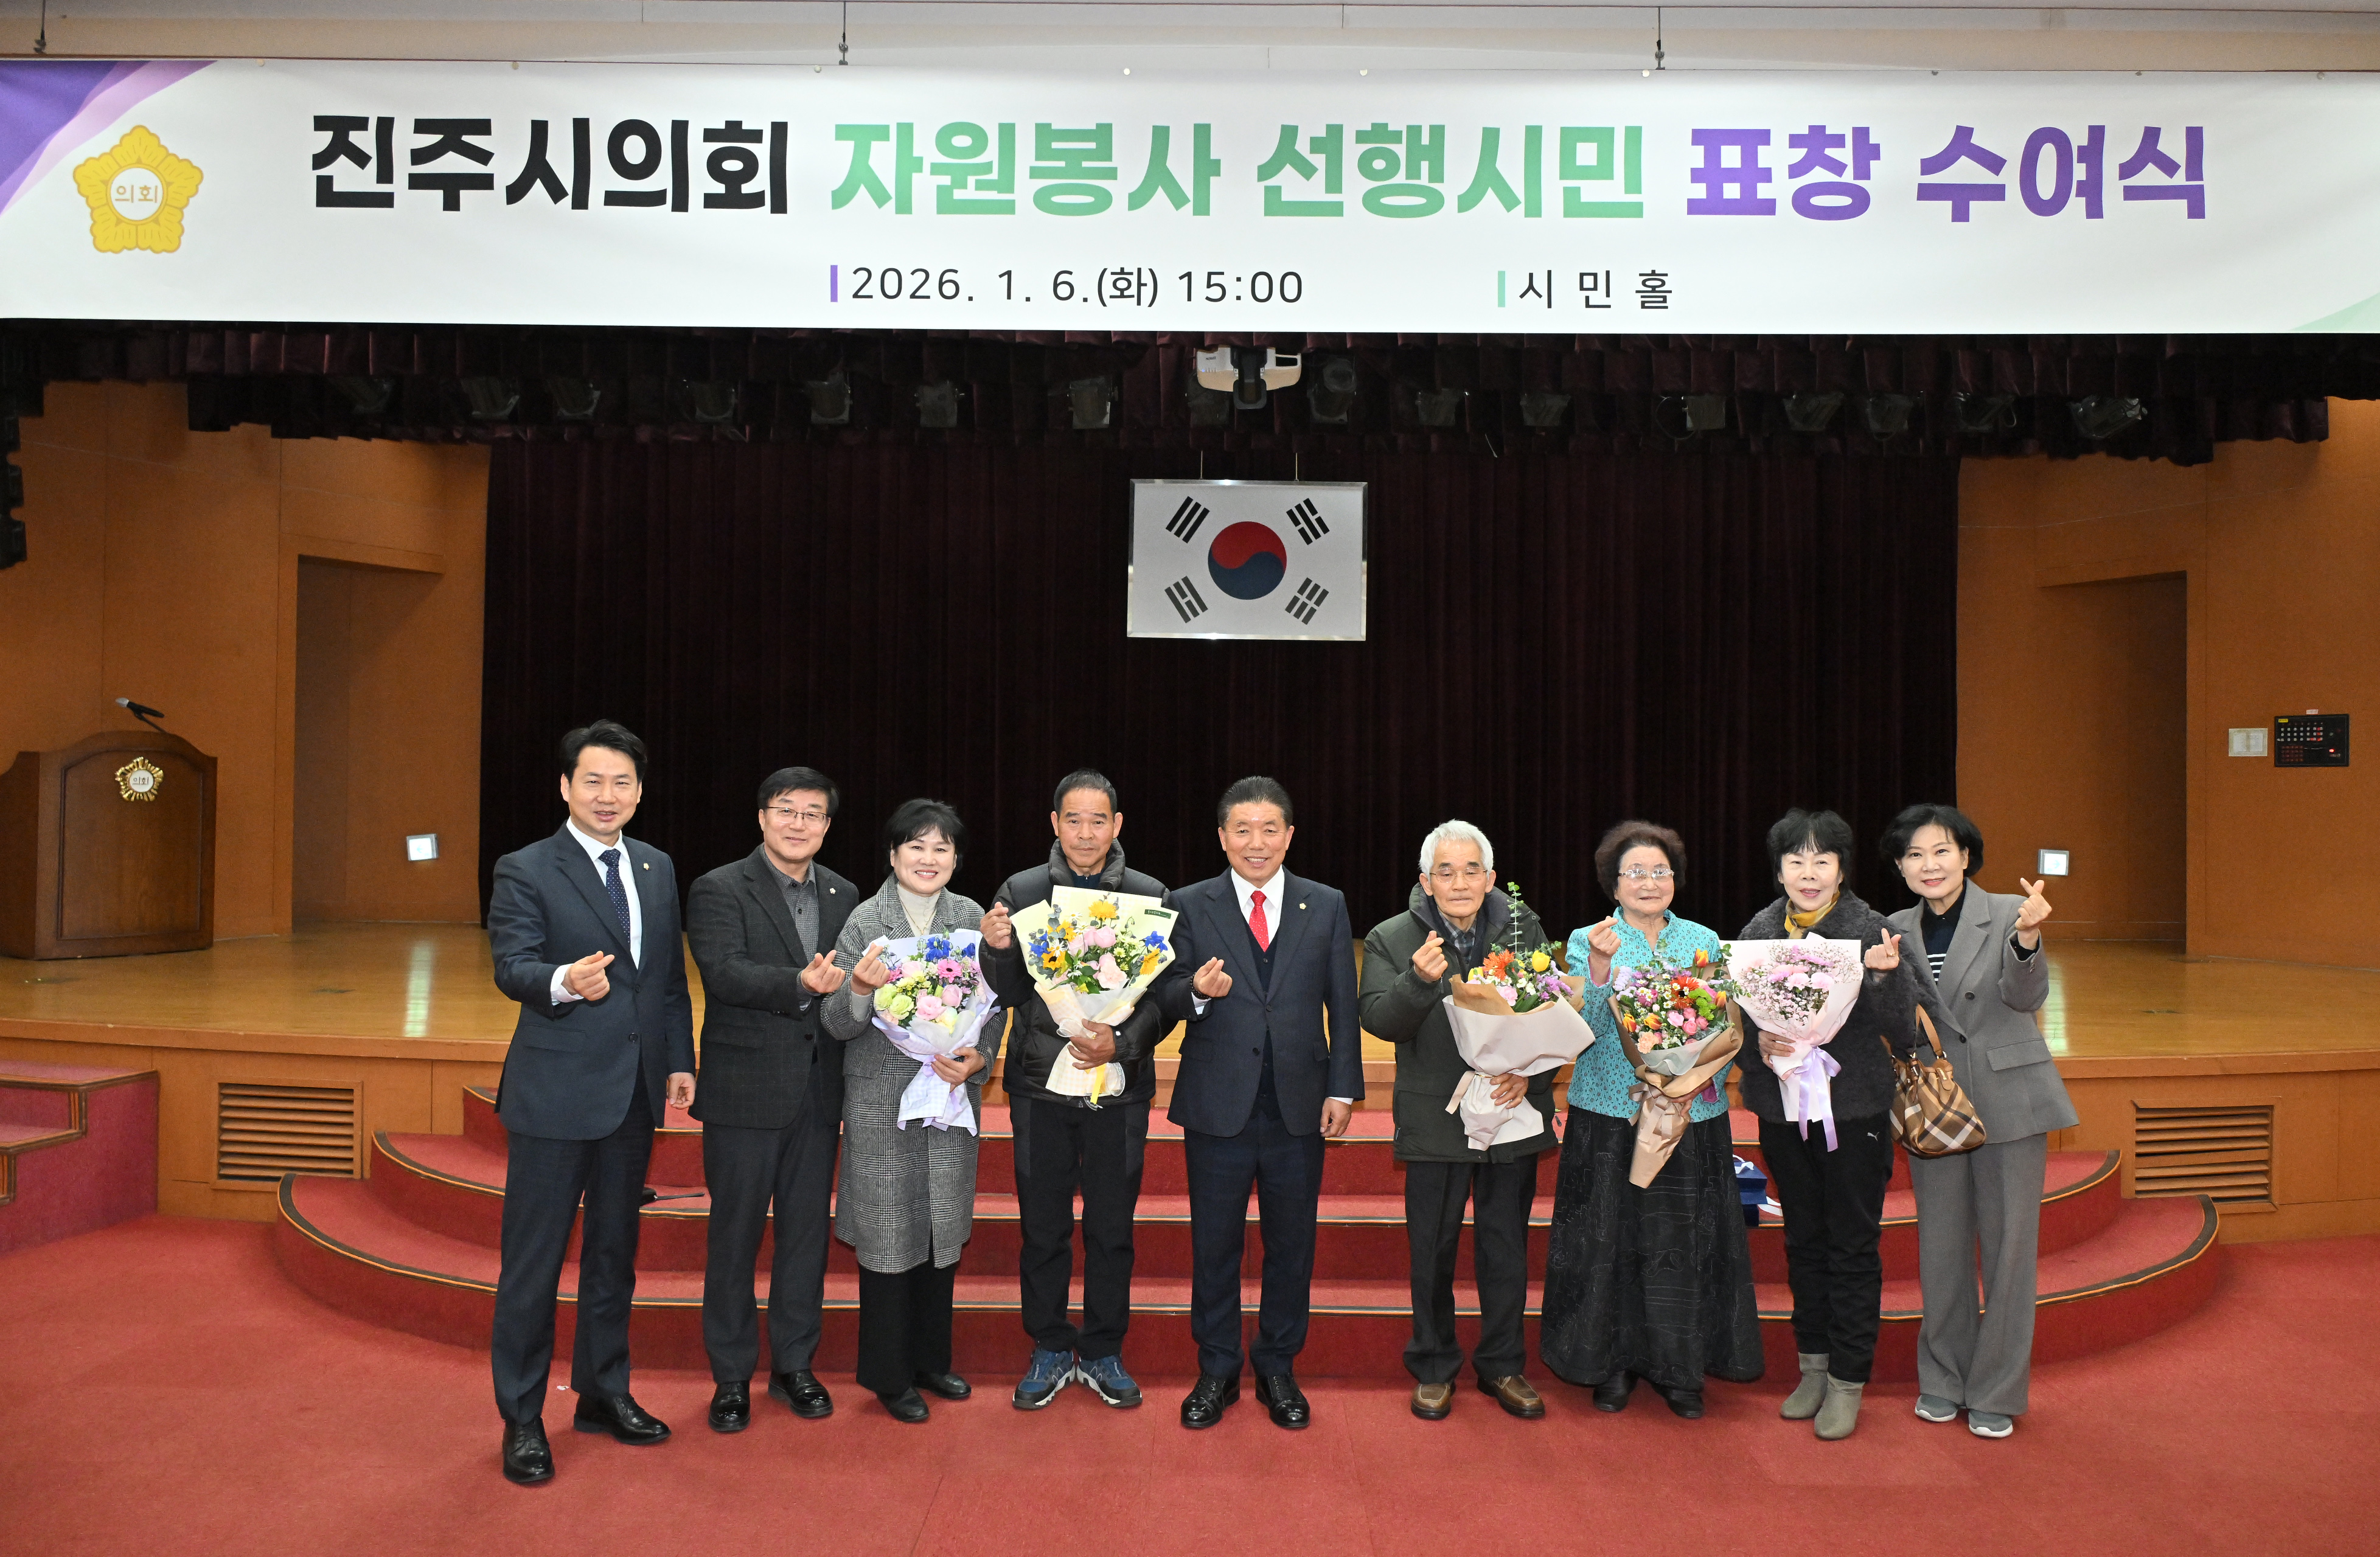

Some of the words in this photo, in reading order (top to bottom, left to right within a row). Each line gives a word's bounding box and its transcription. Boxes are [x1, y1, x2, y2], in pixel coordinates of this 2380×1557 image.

[312, 115, 789, 214] 진주시의회
[831, 121, 1221, 216] 자원봉사
[1258, 122, 1644, 219] 선행시민
[1686, 124, 1881, 221] 표창
[1916, 125, 2206, 223] 수여식
[115, 185, 158, 204] 의회
[852, 267, 974, 302] 2026.
[998, 270, 1031, 302] 1.
[1178, 271, 1303, 303] 15:00
[133, 777, 149, 785] 의회
